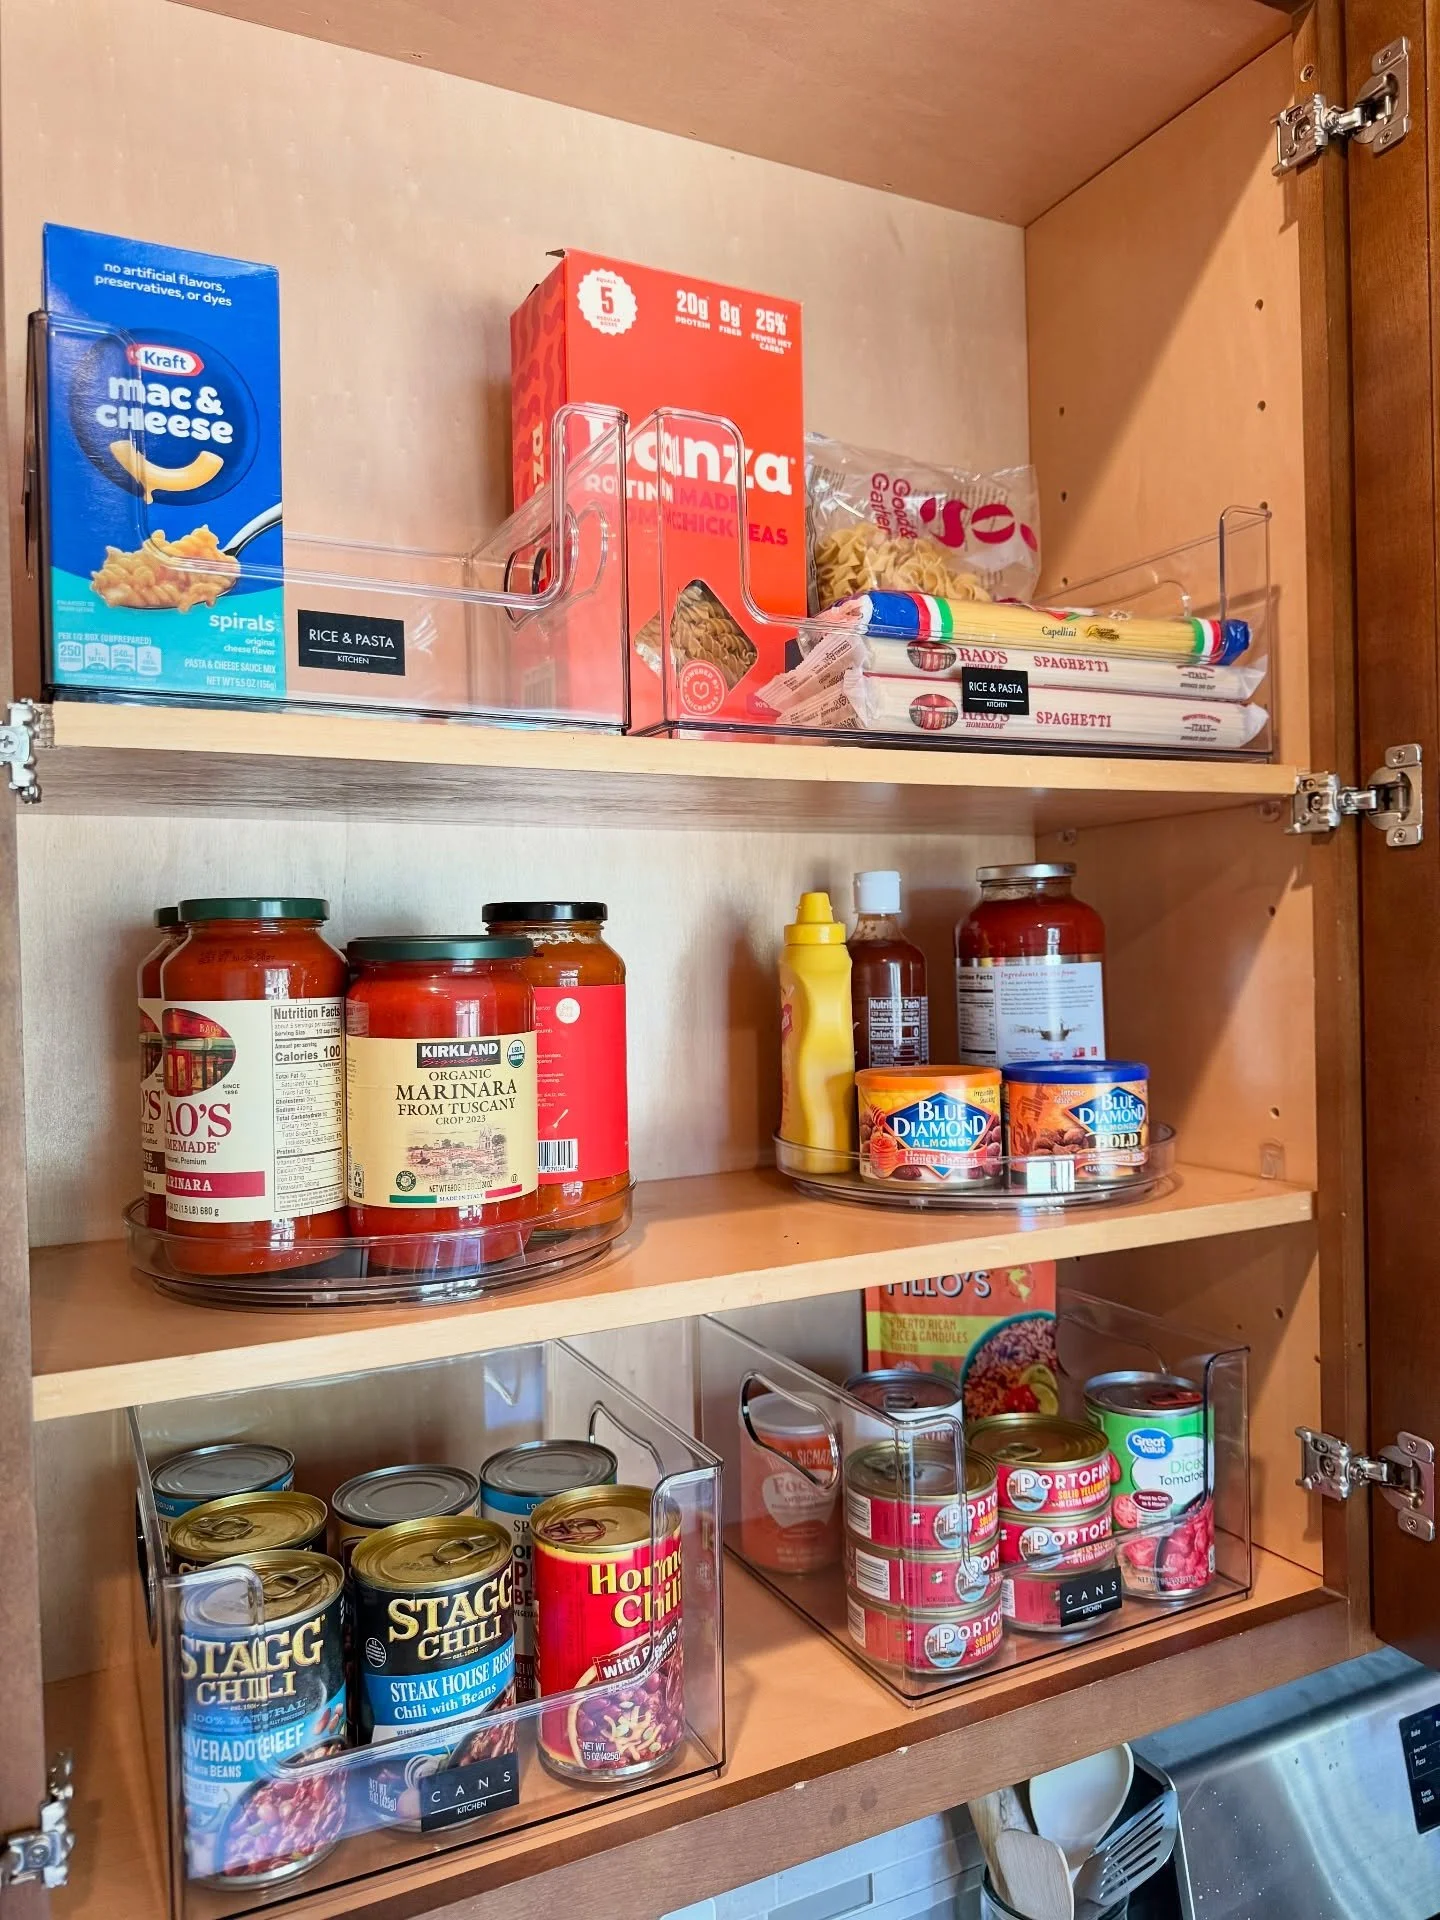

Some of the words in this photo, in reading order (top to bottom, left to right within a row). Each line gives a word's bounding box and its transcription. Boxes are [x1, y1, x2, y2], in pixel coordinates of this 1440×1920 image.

[104, 262, 121, 274] no
[122, 265, 176, 284] artificial
[179, 274, 226, 294] flavors,
[94, 274, 185, 300] preservatives,
[187, 290, 202, 301] or
[203, 292, 232, 307] dyes
[600, 286, 614, 314] 5
[676, 290, 709, 320] 20g
[719, 300, 740, 328] 8g
[755, 308, 787, 336] 25%
[674, 316, 710, 330] PROTEIN
[718, 324, 742, 336] FIBER
[751, 332, 776, 346] FEWER
[777, 338, 792, 348] NET
[759, 342, 785, 354] CARBS
[144, 350, 187, 372] Kraft
[108, 376, 192, 410] mac
[196, 386, 224, 416] &
[584, 473, 674, 505] ROTIN
[870, 471, 893, 541] Gather
[892, 477, 912, 533] Good
[671, 510, 789, 547] CHICKEAS
[208, 612, 275, 633] spirals
[309, 629, 339, 643] RICE
[342, 632, 352, 645] &
[356, 633, 395, 648] PASTA
[1041, 626, 1077, 638] Capellini
[60, 644, 81, 656] 250
[224, 644, 251, 654] cheese
[252, 646, 276, 656] flavor
[245, 636, 276, 648] original
[337, 655, 370, 665] KITCHEN
[958, 648, 1008, 664] RAO'S
[1034, 655, 1110, 672] SPAGHETTI
[184, 658, 206, 670] PASTA
[208, 660, 214, 669] &
[214, 660, 240, 672] CHEESE
[240, 662, 262, 673] SAUCE
[263, 664, 276, 674] MIX
[206, 675, 220, 686] NET
[221, 676, 235, 686] WT
[246, 678, 256, 688] OZ
[968, 681, 988, 692] RICE
[989, 683, 996, 693] &
[998, 684, 1023, 694] PASTA
[684, 694, 720, 712] CHICKPEAS
[966, 722, 1005, 730] HOMEMADE
[1036, 712, 1112, 728] SPAGHETTI
[274, 1006, 318, 1020] Nutrition
[320, 1006, 340, 1018] Facts
[274, 1050, 318, 1062] Calories
[324, 1044, 341, 1058] 100
[421, 1042, 499, 1058] KIRKLAND
[428, 1068, 492, 1082] ORGANIC
[396, 1079, 518, 1102] MARINARA
[398, 1103, 444, 1116] FROM
[448, 1098, 516, 1116] TUSCANY
[918, 1100, 968, 1121] BLUE
[1102, 1094, 1136, 1110] BLUE
[164, 1101, 232, 1138] AO'S
[436, 1116, 464, 1126] CROP
[466, 1115, 486, 1124] 2023
[1080, 1104, 1146, 1125] DIAMOND
[893, 1116, 987, 1138] DIAMOND
[167, 1140, 217, 1154] MEMADE
[912, 1138, 972, 1148] ALMONDS
[1096, 1132, 1138, 1149] BOLD
[180, 1156, 207, 1166] Premium
[166, 1175, 213, 1192] ARINARA
[428, 1184, 438, 1193] NET
[438, 1184, 447, 1192] WT
[200, 1206, 213, 1215] 680
[214, 1208, 220, 1217] g
[928, 1319, 957, 1330] RICAN
[890, 1329, 912, 1340] RICE
[1132, 1435, 1166, 1448] Great
[1141, 1444, 1167, 1455] Value
[1170, 1459, 1204, 1474] Dice
[1021, 1462, 1111, 1492] PORTOFIN
[1160, 1470, 1204, 1486] Tomatoe
[590, 1550, 682, 1595] Horm
[1066, 1581, 1118, 1605] CANS
[388, 1566, 514, 1644] STAGG
[1082, 1604, 1102, 1614] KITCHEN
[418, 1614, 502, 1662] CHILI
[180, 1619, 323, 1680] STAGG
[602, 1653, 640, 1679] with
[196, 1671, 298, 1706] CHILI
[390, 1678, 440, 1703] STEAK
[442, 1662, 490, 1696] HOUSE
[394, 1704, 427, 1720] Chili
[430, 1698, 458, 1715] with
[461, 1682, 497, 1707] Beans
[193, 1712, 224, 1724] 100%
[186, 1736, 256, 1763] LVERADO
[582, 1741, 596, 1750] NET
[596, 1742, 606, 1751] WT
[584, 1751, 591, 1761] 15
[592, 1752, 600, 1761] OZ
[600, 1752, 621, 1762] (425g)
[210, 1764, 242, 1778] BEANS
[432, 1771, 512, 1803] CANS
[456, 1800, 488, 1816] KITCHEN
